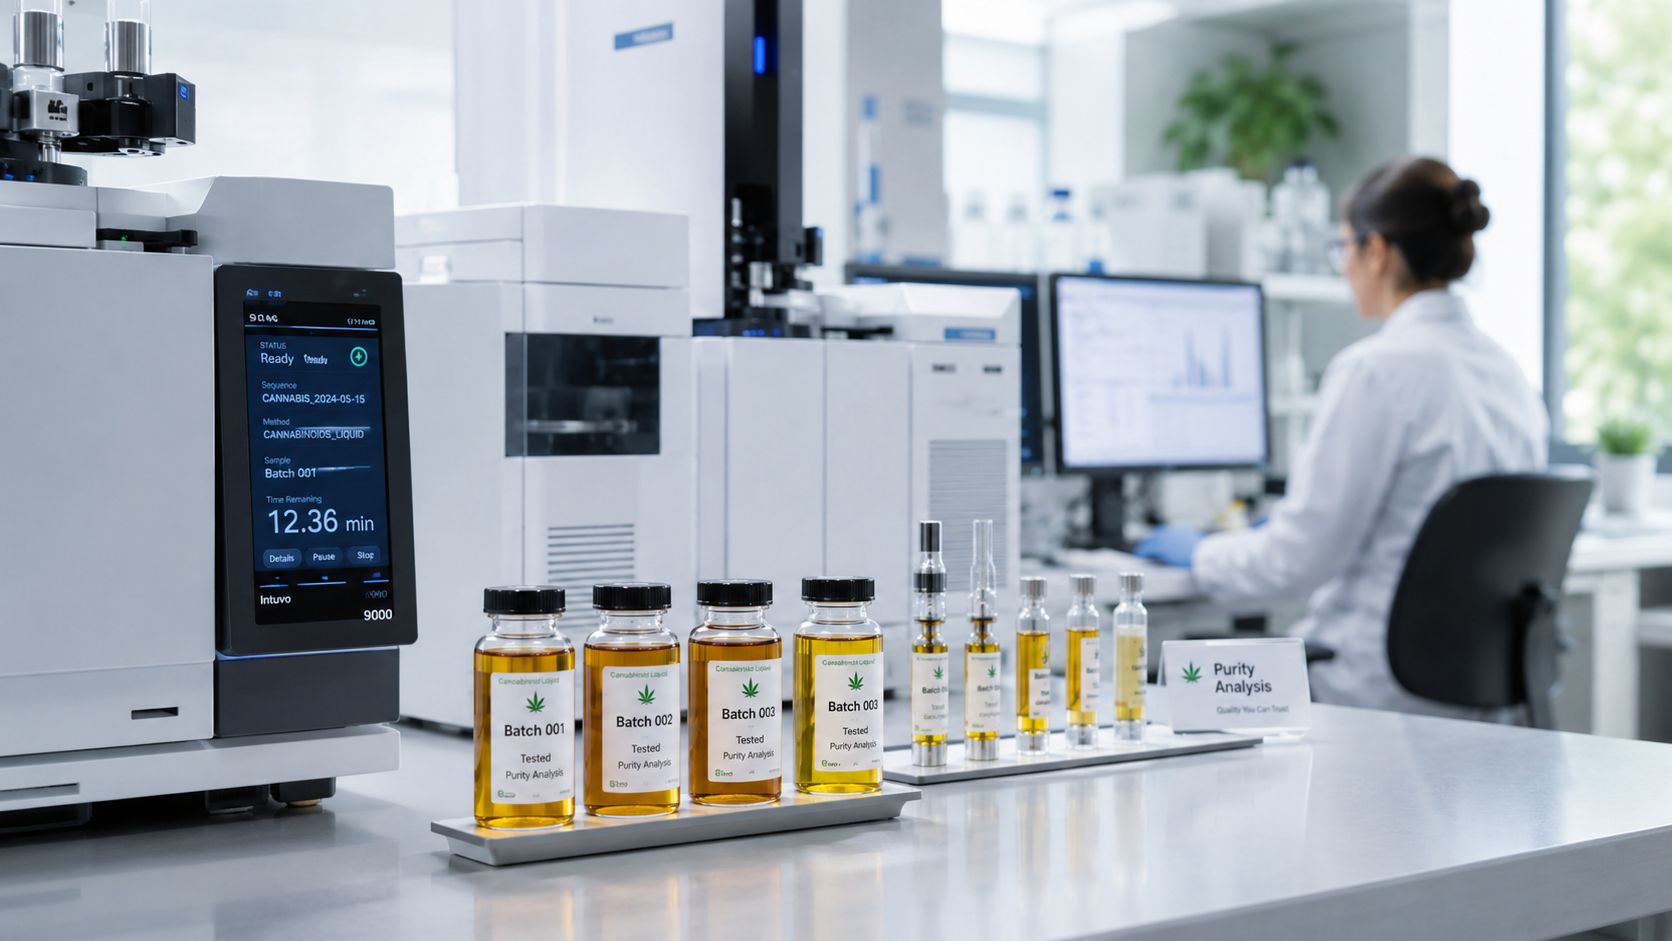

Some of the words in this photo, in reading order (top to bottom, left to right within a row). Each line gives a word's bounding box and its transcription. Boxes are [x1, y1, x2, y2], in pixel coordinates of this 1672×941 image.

[260, 341, 287, 349] STATUS
[261, 353, 294, 366] Ready
[261, 381, 298, 390] Sequence
[262, 393, 366, 405] CANNABIS_2024-05-15
[263, 418, 290, 426] Method
[264, 456, 292, 465] Sample
[265, 468, 295, 478] Batch
[297, 468, 317, 477] 001
[266, 495, 284, 503] Time
[268, 508, 338, 534] 12.36
[346, 515, 374, 532] min
[269, 554, 295, 563] Details
[312, 553, 336, 561] Pause
[260, 595, 291, 605] Intuvo
[363, 609, 393, 621] 9000
[1213, 662, 1255, 678] Purity
[1215, 680, 1272, 696] Analysis
[828, 701, 860, 712] Batch
[863, 699, 879, 711] 003
[722, 708, 756, 720] Batch
[758, 706, 776, 719] 003
[616, 715, 652, 728] Batch
[655, 713, 673, 726] 002
[504, 724, 542, 737] Batch
[545, 722, 565, 735] 001
[843, 726, 869, 736] Tested
[736, 735, 765, 744] Tested
[632, 744, 661, 754] Tested
[829, 742, 852, 751] Purity
[520, 753, 551, 763] Tested
[723, 751, 746, 761] Purity
[748, 749, 775, 760] Analysis
[618, 761, 642, 771] Purity
[643, 758, 672, 770] Analysis
[505, 770, 530, 782] Purity
[532, 768, 564, 781] Analysis
